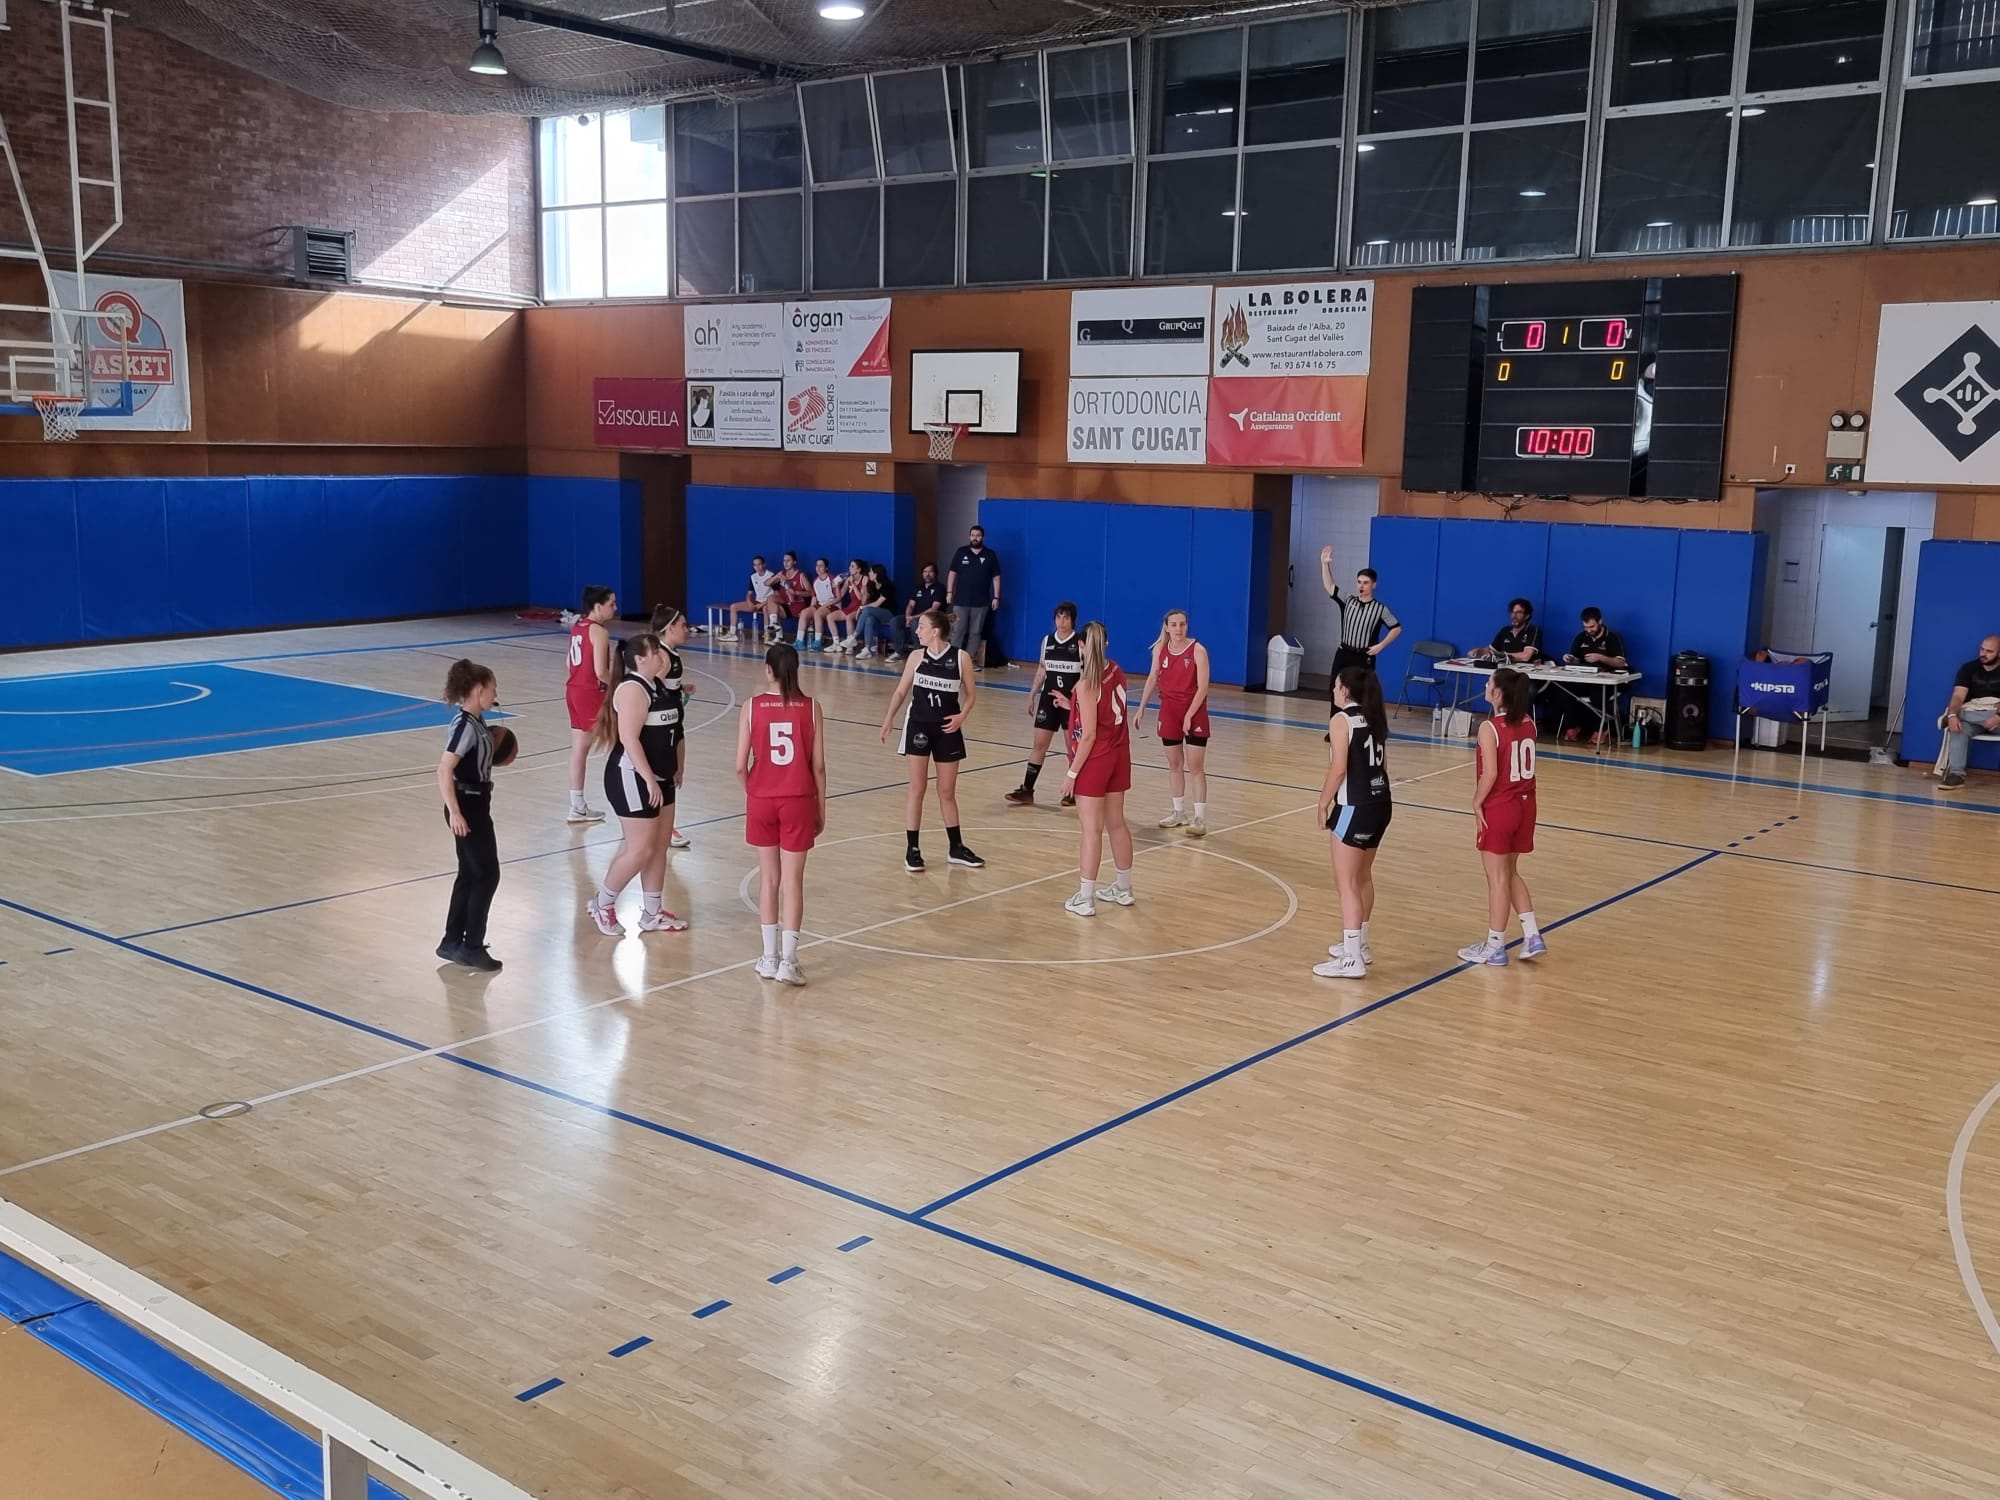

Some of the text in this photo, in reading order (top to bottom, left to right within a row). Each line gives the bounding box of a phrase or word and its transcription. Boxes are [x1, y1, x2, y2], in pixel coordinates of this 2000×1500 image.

[1248, 287, 1367, 307] LA BOLERA
[1248, 305, 1367, 317] RESTAURANT BRASERIA
[1267, 322, 1345, 332] Baixada de l'Alba, 20
[1526, 323, 1543, 348] 0
[1606, 321, 1624, 347] 0
[1267, 333, 1344, 344] Sant Cugat del Vallès
[1252, 349, 1363, 358] www.restaurantlabolera.com
[82, 353, 167, 376] ASKET
[1269, 361, 1337, 370] Tel. 93 674 16 75
[1497, 360, 1624, 381] 0 0
[826, 383, 835, 431] ESPORTS
[1073, 390, 1202, 415] ORTODONCIA
[616, 409, 680, 427] SISQUELLA
[1250, 410, 1342, 422] Catalana Occident
[1250, 423, 1294, 431] Assegurances
[786, 433, 806, 444] SANT
[808, 433, 834, 445] CUGAT
[1072, 426, 1202, 451] SANT CUGAT
[1527, 430, 1592, 455] 10:00
[1056, 675, 1064, 688] 6
[927, 692, 942, 707] 11
[769, 722, 795, 766] 5
[1510, 737, 1536, 782] 10
